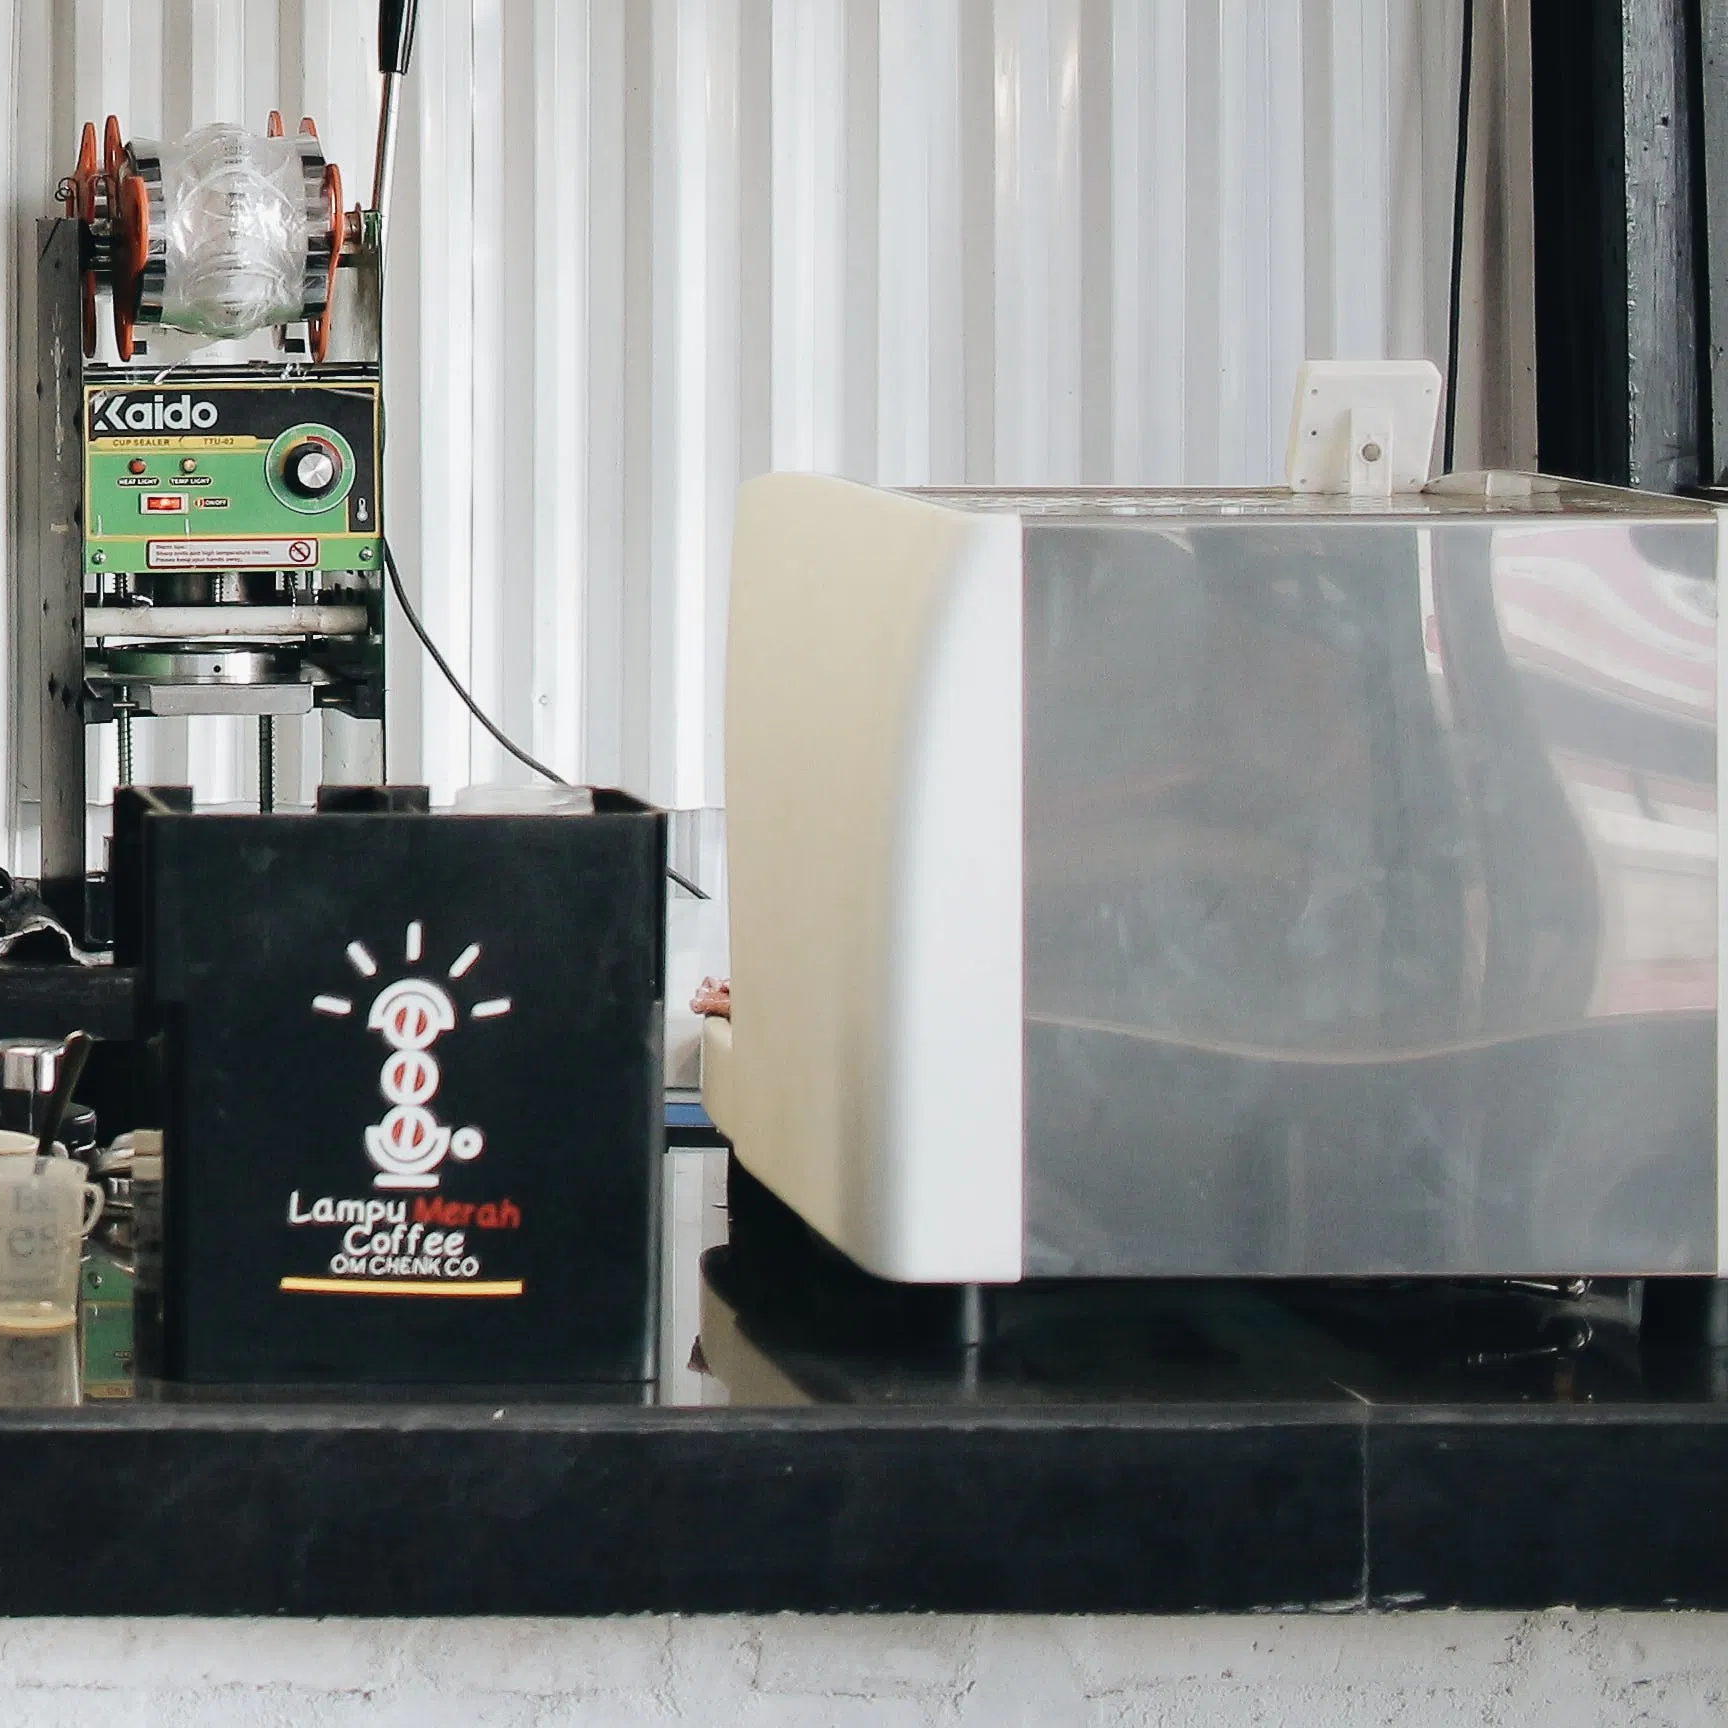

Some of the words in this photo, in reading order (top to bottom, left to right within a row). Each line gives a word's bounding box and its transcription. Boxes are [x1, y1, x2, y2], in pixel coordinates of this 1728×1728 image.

[94, 394, 219, 431] Kaido
[135, 438, 170, 446] SEALER
[288, 1190, 407, 1230] Lampu
[413, 1196, 521, 1229] Merah
[344, 1224, 465, 1257] Coffee
[330, 1253, 367, 1275] OM
[369, 1255, 443, 1277] CHENK
[444, 1256, 480, 1278] CO
